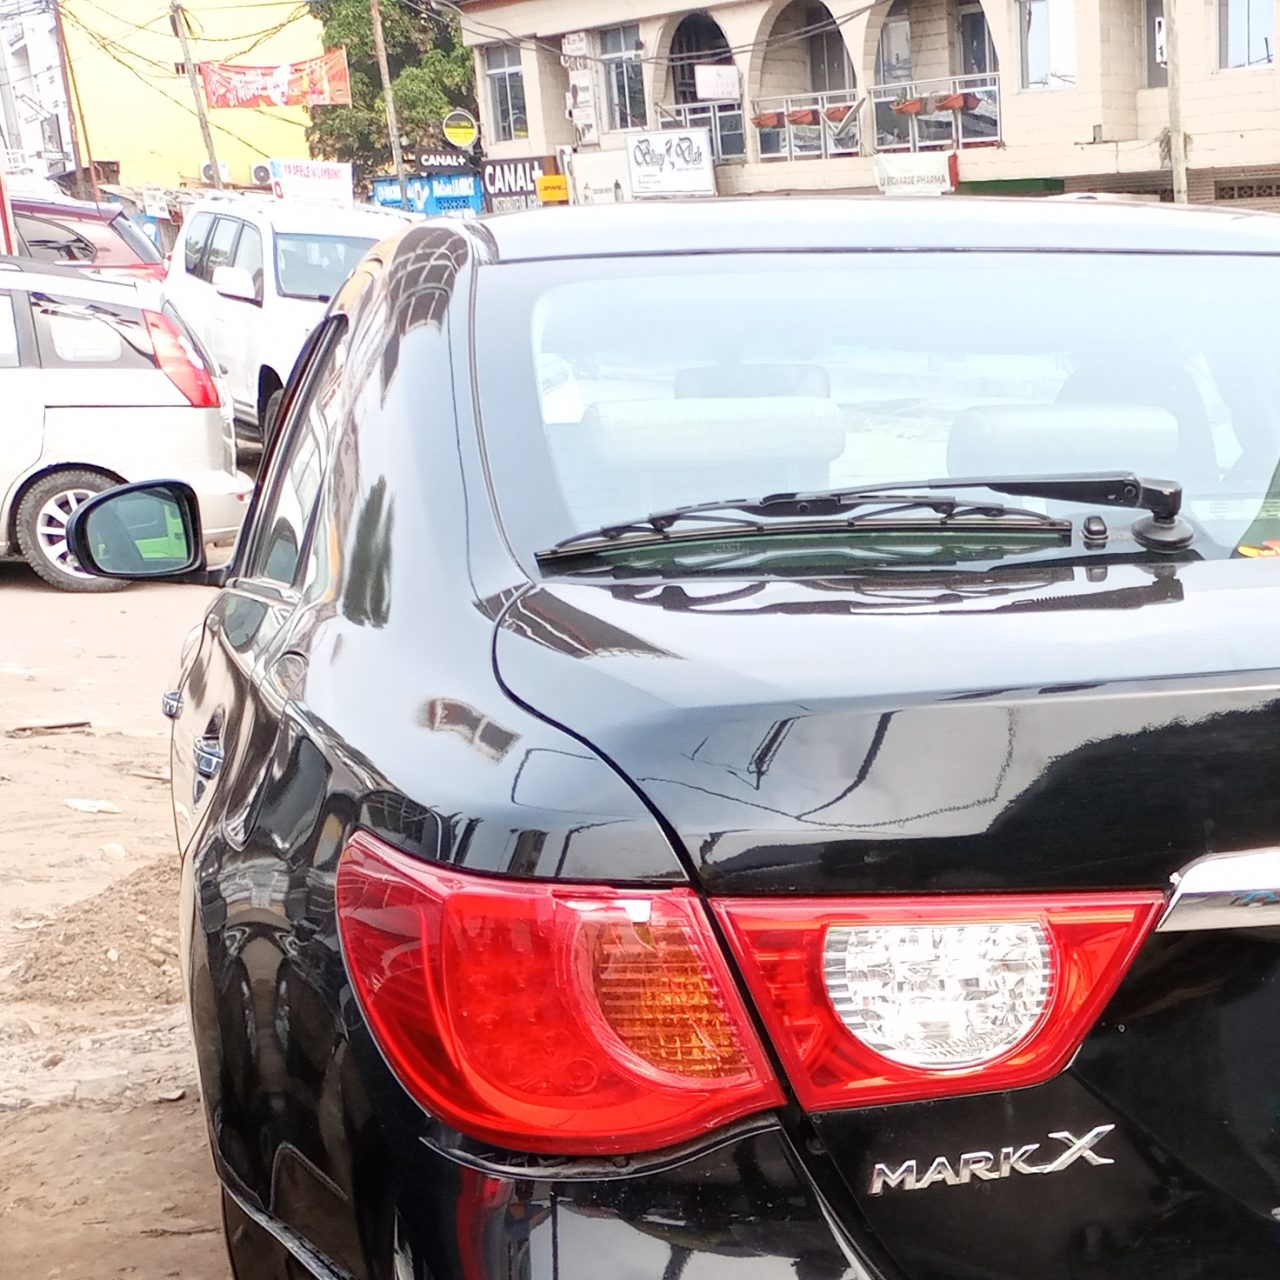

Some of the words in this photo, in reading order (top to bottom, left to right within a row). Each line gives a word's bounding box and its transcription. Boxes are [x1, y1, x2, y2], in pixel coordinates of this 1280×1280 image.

[420, 153, 467, 167] CANAL+
[484, 160, 544, 196] CANAL+
[868, 1143, 1042, 1197] MARK
[1036, 1123, 1116, 1174] X
